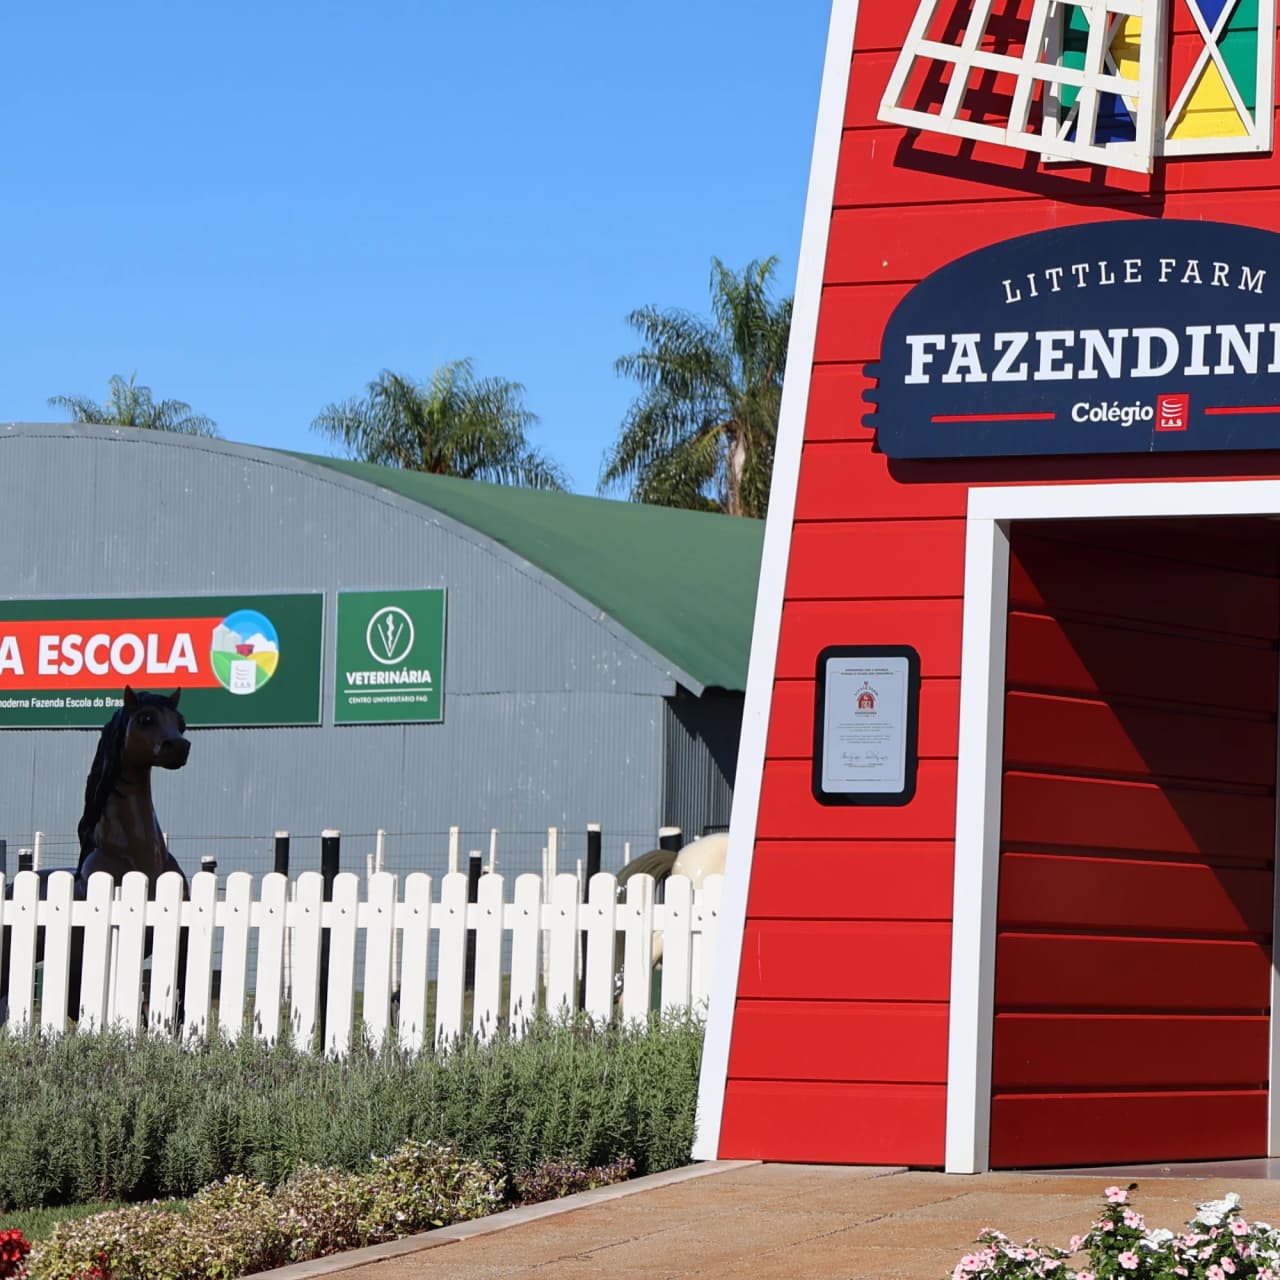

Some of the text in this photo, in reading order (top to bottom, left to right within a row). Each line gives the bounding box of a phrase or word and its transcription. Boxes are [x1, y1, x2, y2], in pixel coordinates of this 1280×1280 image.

[1002, 259, 1266, 304] LITTLE FARM
[1071, 401, 1154, 427] Colégio
[38, 632, 199, 676] ESCOLA
[346, 666, 432, 686] VETERINÁRIA
[31, 697, 65, 708] Fazenda
[65, 697, 92, 708] Escola
[93, 697, 104, 708] do
